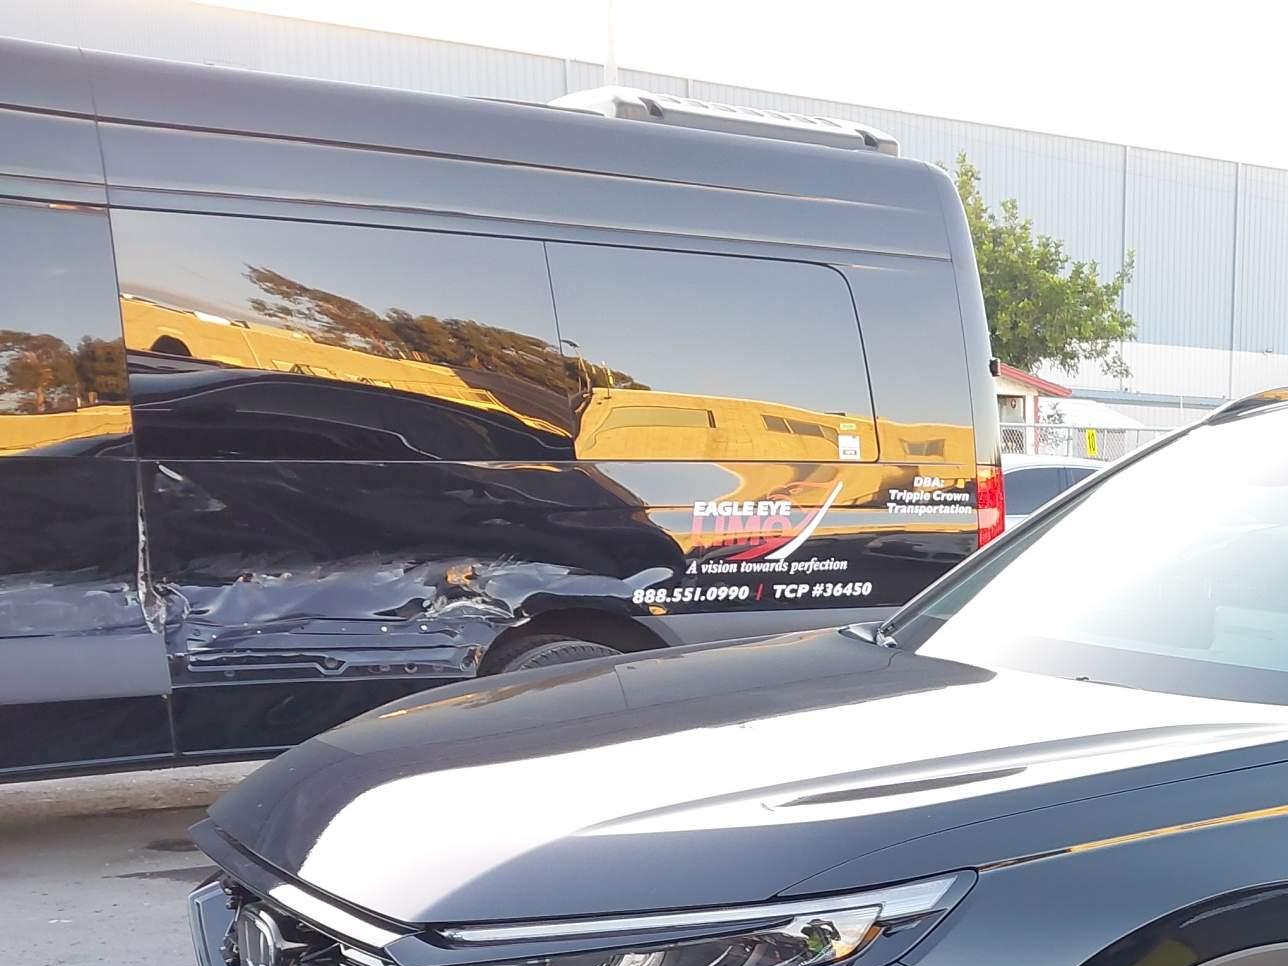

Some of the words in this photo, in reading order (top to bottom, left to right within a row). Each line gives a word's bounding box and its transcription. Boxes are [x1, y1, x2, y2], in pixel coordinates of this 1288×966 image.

[913, 476, 945, 488] DBA:
[888, 489, 930, 503] Tripple
[932, 490, 970, 502] Crown
[693, 500, 755, 517] EAGLE
[757, 500, 793, 517] EYE
[886, 502, 973, 516] Transportation
[690, 515, 793, 547] LIMO
[685, 560, 698, 575] A
[701, 559, 738, 574] vision
[740, 558, 789, 573] towards
[789, 557, 849, 575] perfection
[632, 585, 750, 604] 888.551.0990
[773, 583, 809, 599] TCP
[811, 581, 873, 598] #36450
